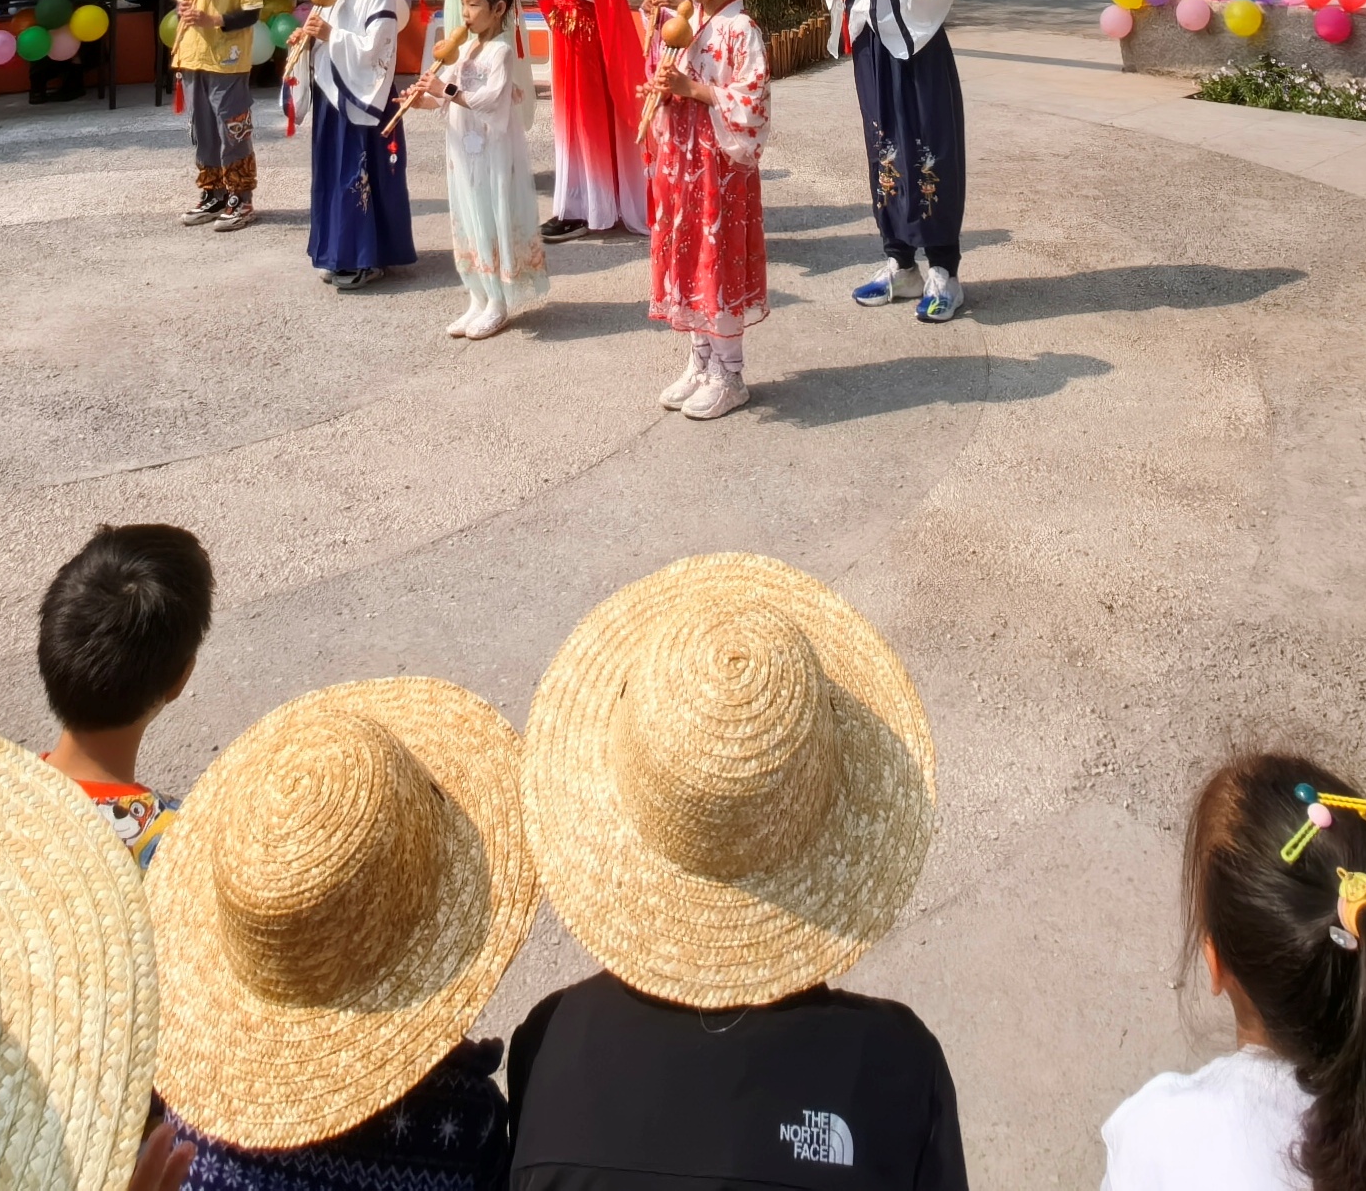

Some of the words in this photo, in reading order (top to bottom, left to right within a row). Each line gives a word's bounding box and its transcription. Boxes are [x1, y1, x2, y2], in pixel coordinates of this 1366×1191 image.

[802, 1109, 830, 1129] THE
[779, 1123, 830, 1147] NORTH
[793, 1142, 829, 1163] FACE
